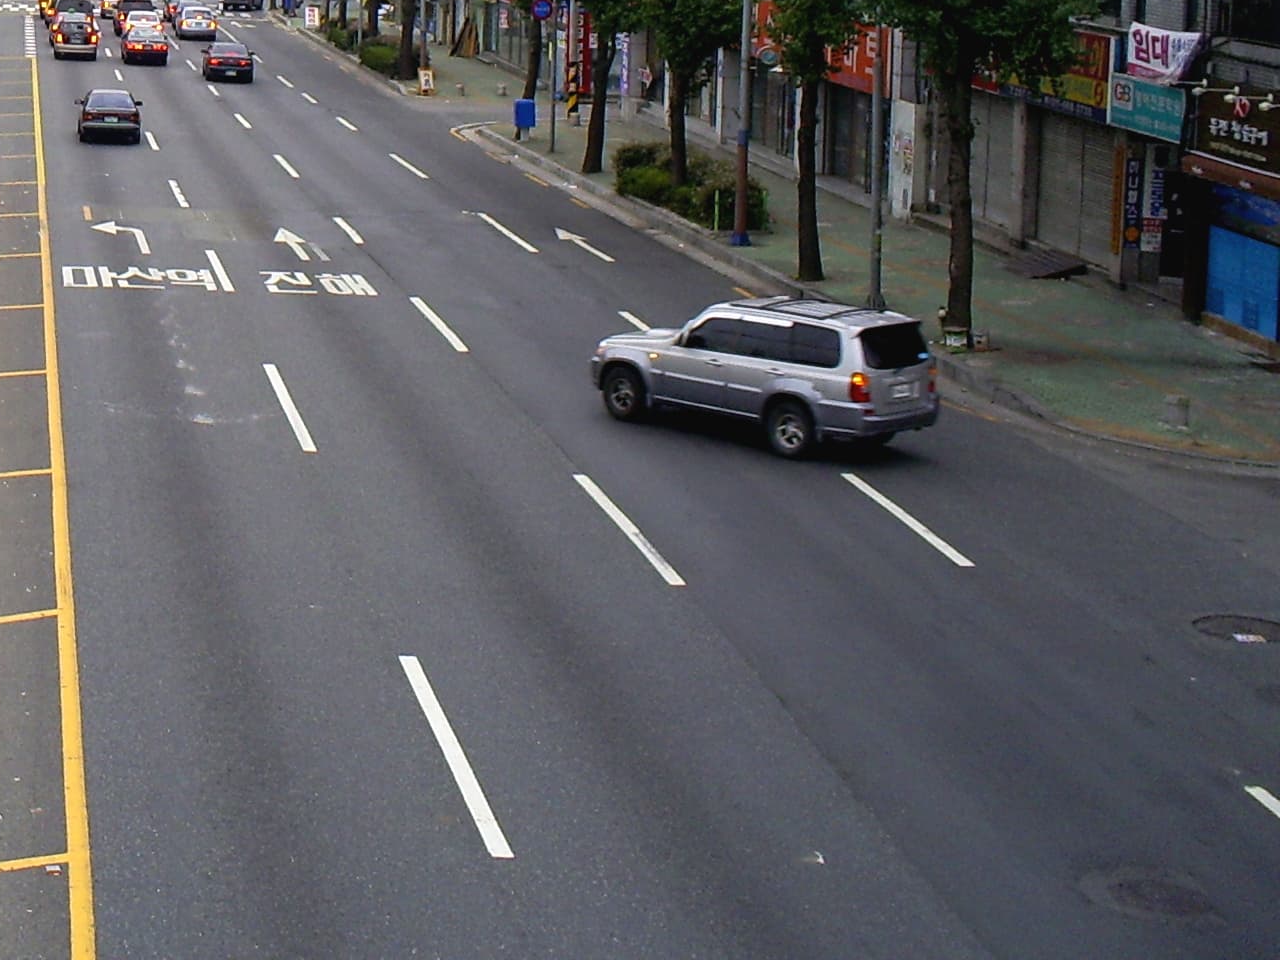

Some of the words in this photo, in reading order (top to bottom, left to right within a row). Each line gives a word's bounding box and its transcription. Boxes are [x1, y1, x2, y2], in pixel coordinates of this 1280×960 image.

[1133, 28, 1170, 68] 임대
[62, 266, 219, 292] 마산역
[259, 271, 378, 296] 진해
